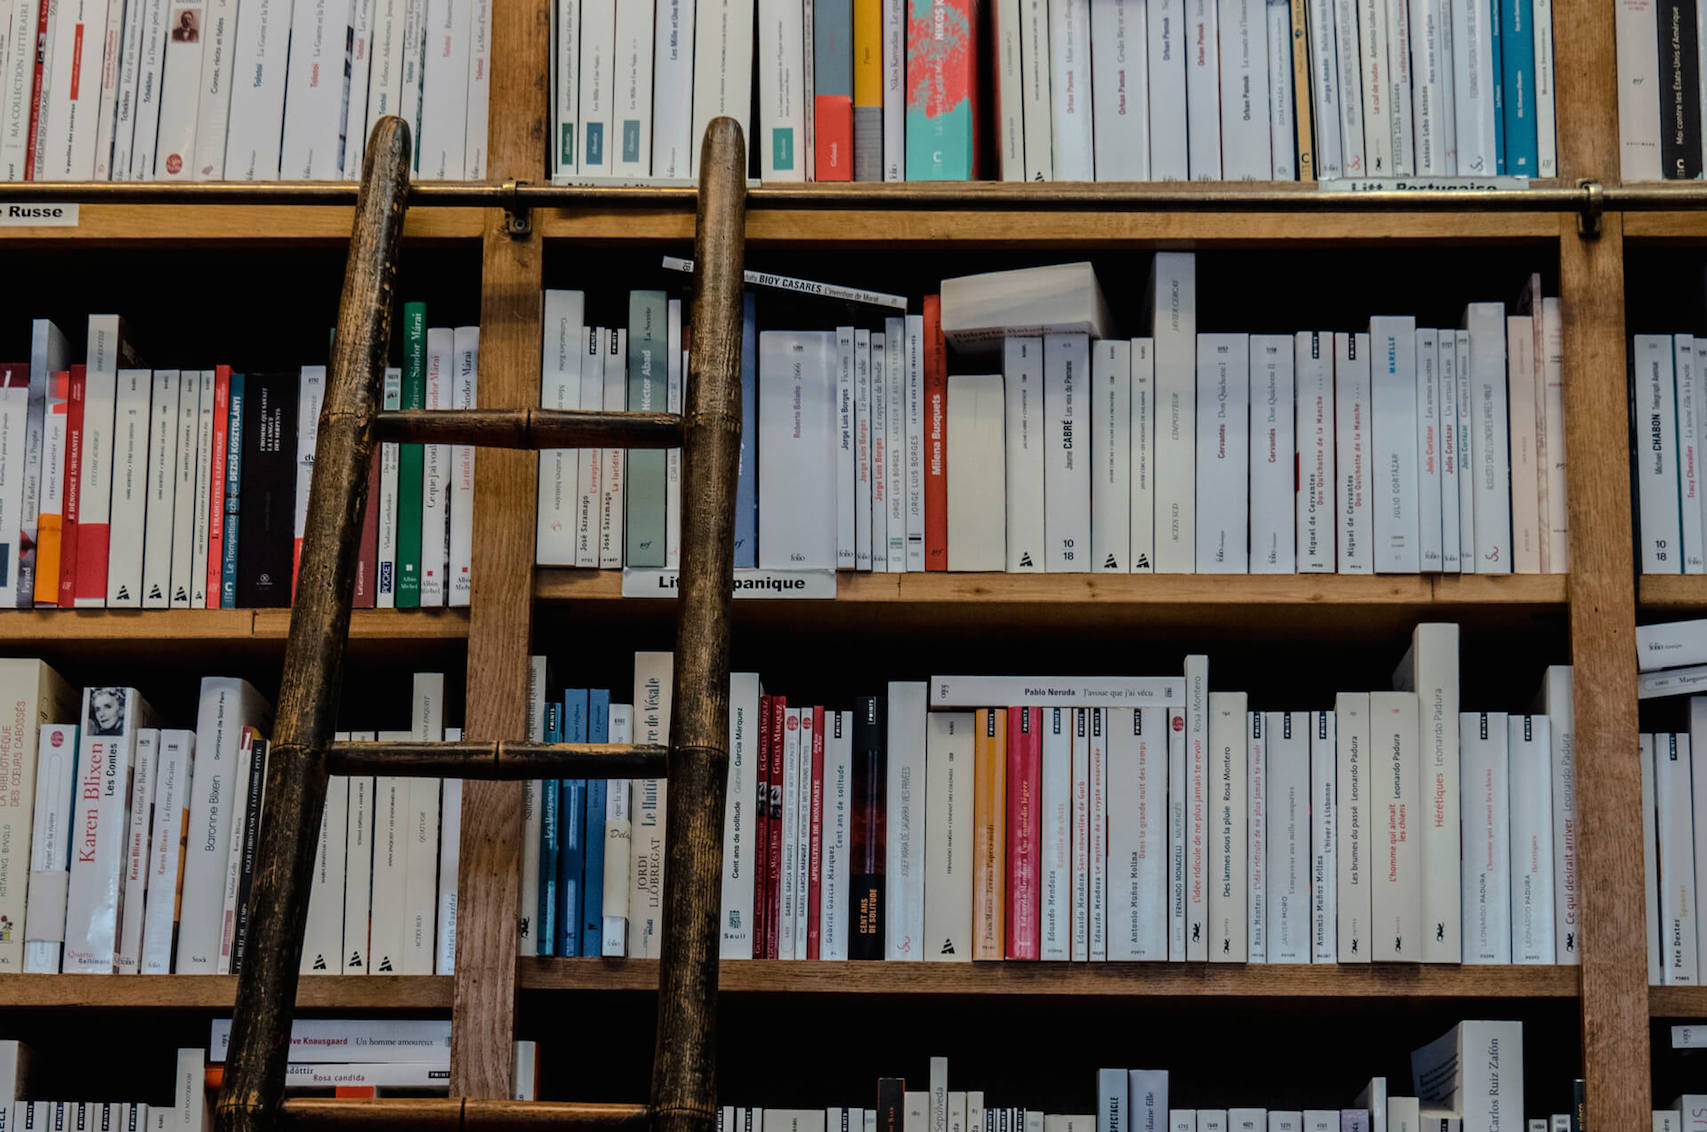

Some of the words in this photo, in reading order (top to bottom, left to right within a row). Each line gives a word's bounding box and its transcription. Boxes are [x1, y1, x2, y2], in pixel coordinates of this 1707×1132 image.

[1672, 6, 1680, 49] d'Amérique
[1673, 51, 1681, 89] États-Unis
[12, 59, 24, 120] COLLECTION
[11, 122, 19, 137] MA
[9, 206, 63, 217] Russe
[759, 275, 779, 286] BIOY
[782, 278, 822, 293] CASARES
[462, 351, 472, 378] Márai
[642, 350, 651, 376] Abad
[642, 379, 651, 410] Héctor
[932, 394, 942, 439] Busquets
[1062, 420, 1072, 448] CABRÉ
[1316, 438, 1323, 446] de
[1652, 414, 1661, 451] CHABON
[932, 442, 941, 475] Milena
[1354, 443, 1360, 451] de
[1390, 454, 1400, 493] CORTÁZAR
[1686, 446, 1694, 478] Chevalier
[612, 483, 618, 492] La
[1308, 474, 1316, 512] Cervantes
[1346, 475, 1354, 514] Cervantes
[1686, 481, 1695, 498] Tracy
[581, 496, 591, 532] Saramago
[603, 492, 612, 530] Saramago
[1308, 516, 1316, 525] de
[1347, 517, 1354, 527] de
[580, 535, 589, 551] José
[602, 533, 611, 551] José
[1064, 539, 1074, 547] 10
[1308, 529, 1317, 555] Miguel
[1347, 530, 1355, 557] Miguel
[1064, 552, 1074, 560] 18
[1655, 553, 1666, 561] 18
[381, 562, 392, 594] POCKET
[659, 576, 679, 587] Lit
[733, 577, 805, 591] panique
[1192, 679, 1201, 712] Montero
[1433, 688, 1443, 721] Padura
[1193, 715, 1201, 732] Rosa
[1193, 740, 1201, 763] revoir
[1350, 736, 1359, 763] Padura
[1391, 734, 1401, 761] Padura
[1432, 723, 1443, 767] Leonardo
[1561, 733, 1572, 766] Padura
[84, 743, 103, 800] Blixen
[106, 743, 118, 776] Contes
[1194, 765, 1201, 773] te
[1223, 747, 1231, 780] Montero
[105, 780, 114, 796] Les
[209, 775, 221, 803] Blixen
[837, 765, 845, 797] solitude
[1193, 776, 1203, 803] jamais
[1223, 782, 1231, 801] Rosa
[1350, 765, 1359, 801] Leonardo
[1391, 763, 1401, 799] Leonardo
[1561, 768, 1572, 812] Leonardo
[163, 791, 172, 810] ferme
[836, 801, 844, 810] de
[1193, 805, 1203, 821] plus
[1323, 783, 1331, 817] Lisbonne
[1433, 773, 1444, 827] Hérétiques
[163, 812, 171, 822] La
[205, 807, 217, 851] Baronne
[1194, 824, 1201, 833] ne
[1223, 806, 1233, 826] pluie
[1350, 807, 1360, 828] passé
[1388, 804, 1396, 828] aimait
[1398, 804, 1407, 828] chiens
[79, 809, 99, 863] Karen
[160, 829, 169, 853] Blixen
[836, 832, 844, 848] Cent
[1193, 836, 1201, 845] de
[1323, 827, 1332, 853] L'hiver
[1350, 831, 1358, 839] du
[1388, 830, 1398, 844] qui
[1563, 819, 1573, 852] arriver
[158, 854, 167, 875] Karen
[1193, 847, 1201, 878] ridicule
[1223, 856, 1231, 882] larmes
[1350, 842, 1358, 870] brumes
[1389, 846, 1397, 882] L'homme
[638, 855, 648, 890] JORDI
[649, 838, 660, 908] LLOBREGAT
[1350, 873, 1358, 885] Les
[1563, 856, 1574, 891] désirait
[1130, 881, 1138, 908] Muñoz
[1193, 881, 1201, 903] L'idée
[1223, 883, 1231, 897] Des
[1315, 885, 1324, 911] Muñoz
[1565, 894, 1577, 909] qui
[869, 889, 878, 922] SOLITUDE
[1564, 912, 1574, 925] Ce
[860, 916, 868, 933] CENT
[869, 924, 876, 933] DE
[1048, 909, 1056, 941] Eduardo
[304, 1038, 348, 1046] Knausgaard
[356, 1038, 367, 1046] Un
[369, 1038, 395, 1046] homme
[1489, 1038, 1498, 1070] Zafón
[1488, 1073, 1499, 1097] Ruiz
